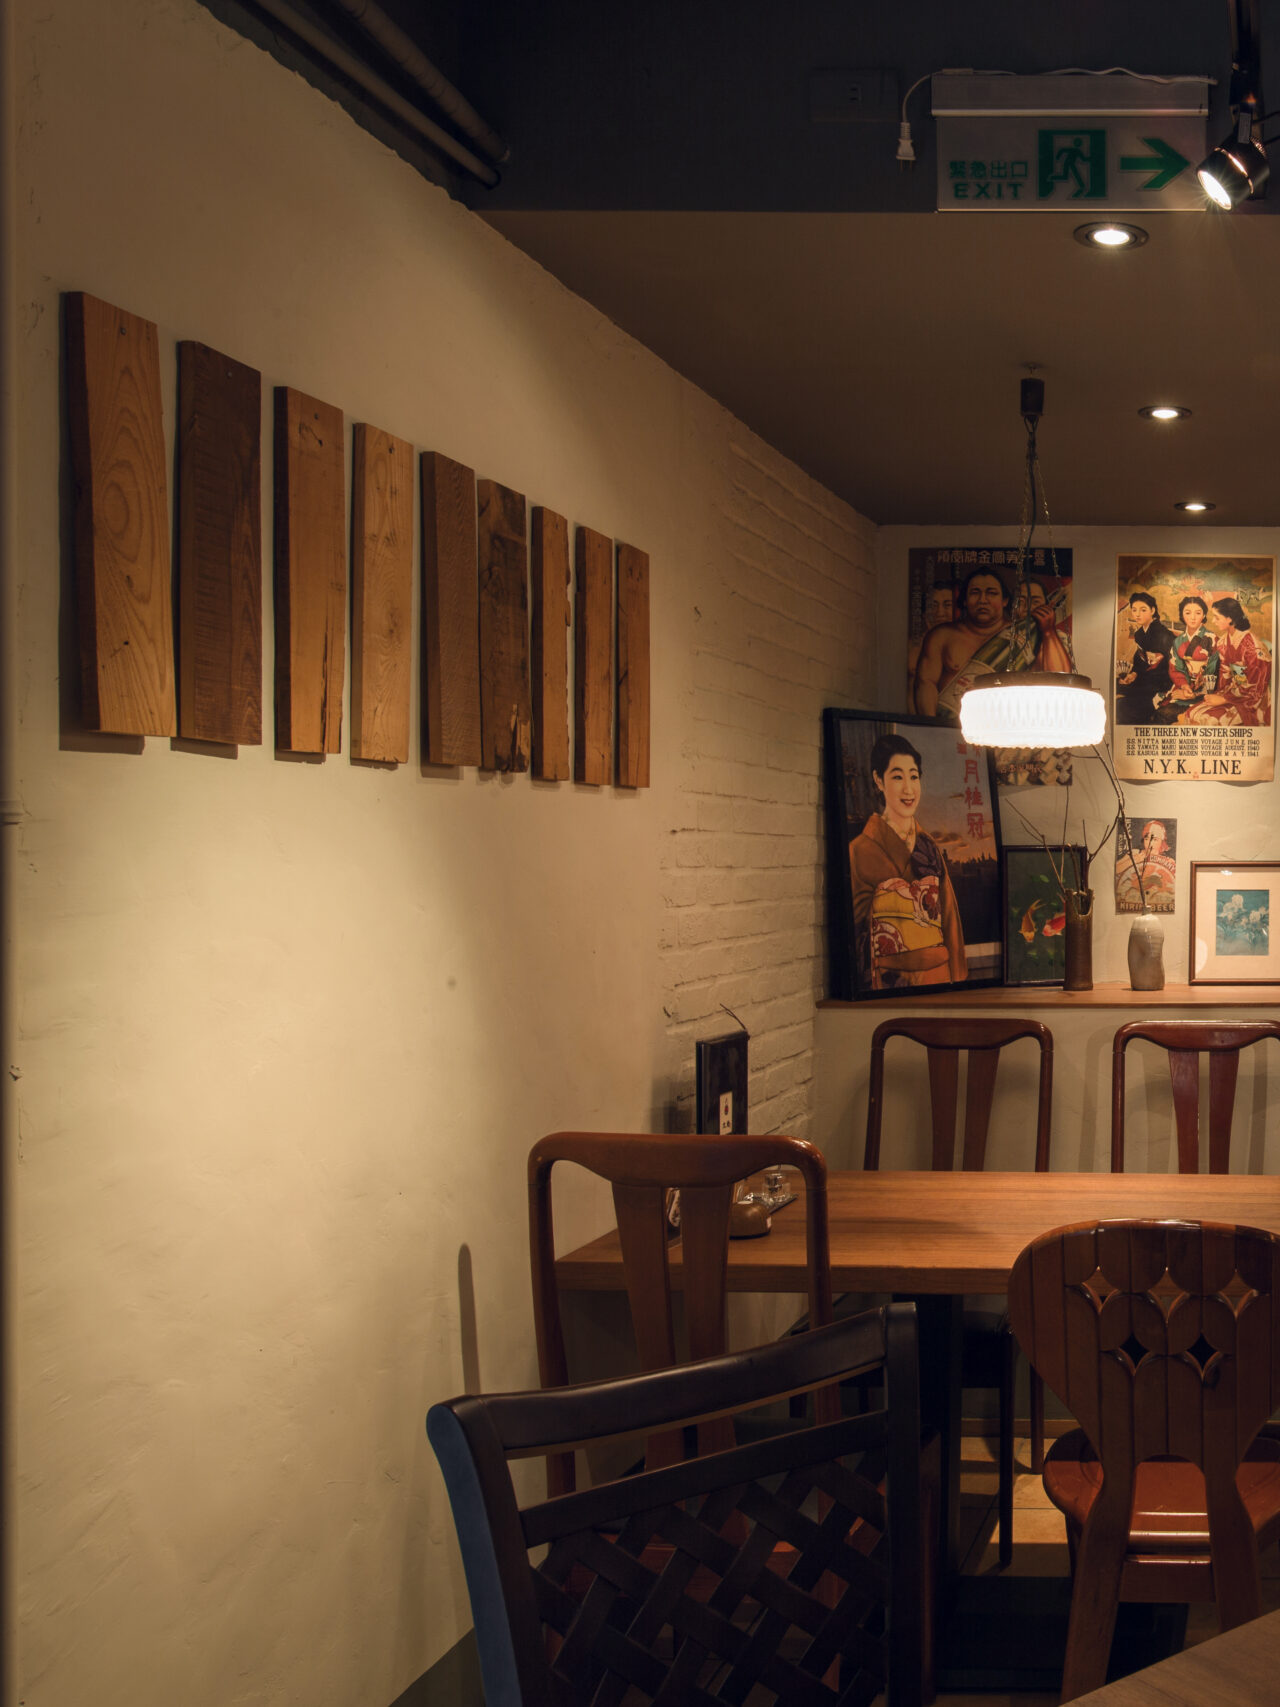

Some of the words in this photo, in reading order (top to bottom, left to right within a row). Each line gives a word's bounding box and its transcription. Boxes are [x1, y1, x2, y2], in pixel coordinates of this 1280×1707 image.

[949, 160, 1029, 180] 緊急出口
[953, 183, 1024, 199] EXIT
[1134, 727, 1150, 737] THE
[1152, 727, 1179, 737] THREE
[1180, 728, 1198, 738] NEW
[1199, 728, 1228, 738] SISTER
[1229, 728, 1253, 738] SHIPS
[1143, 759, 1191, 774] N.Y.K.
[1201, 759, 1242, 775] LINE
[1151, 903, 1175, 912] BEER
